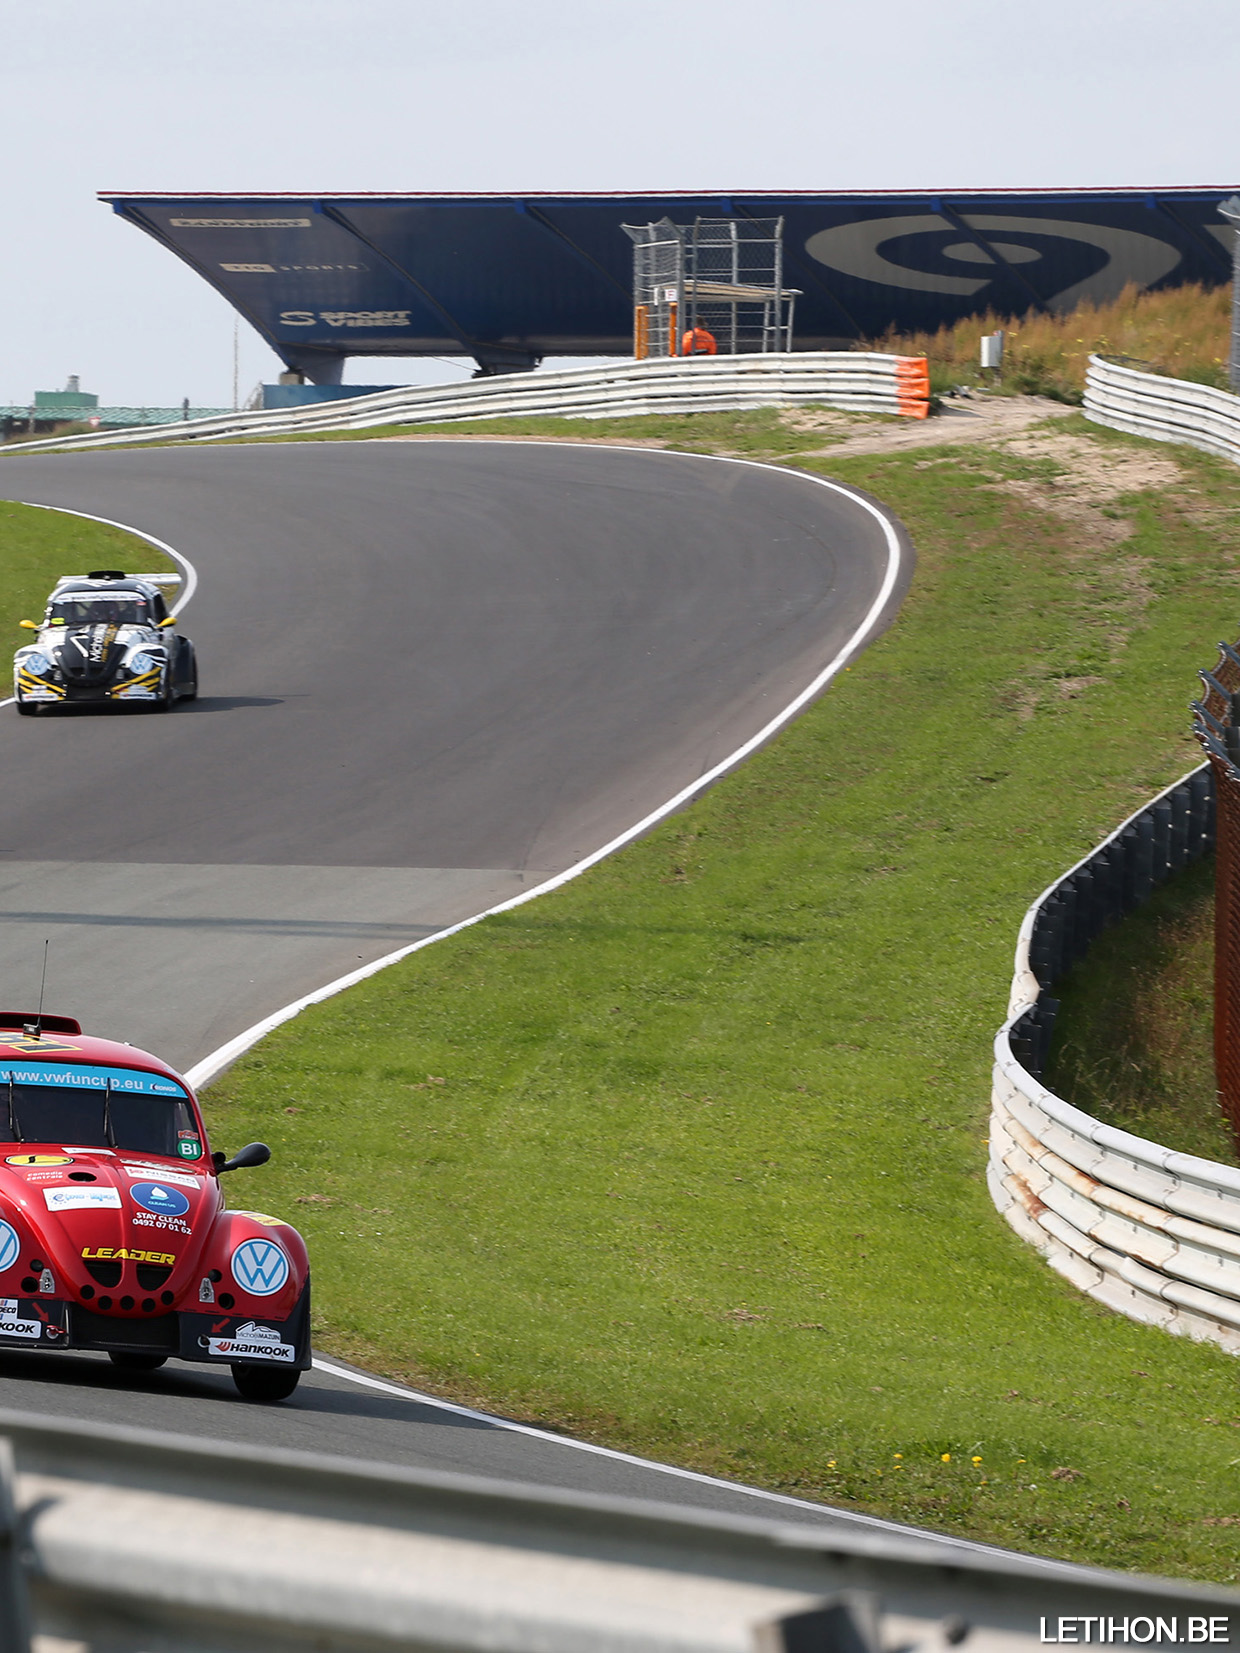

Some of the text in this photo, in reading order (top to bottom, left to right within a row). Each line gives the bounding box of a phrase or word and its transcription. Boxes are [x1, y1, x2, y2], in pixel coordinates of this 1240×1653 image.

[1, 1070, 144, 1090] www.vwfuncup.eu
[181, 1143, 197, 1155] BI
[132, 1218, 192, 1235] 0492 07 01 62
[136, 1212, 187, 1227] STAY CLEAN
[81, 1247, 176, 1265] LEADER
